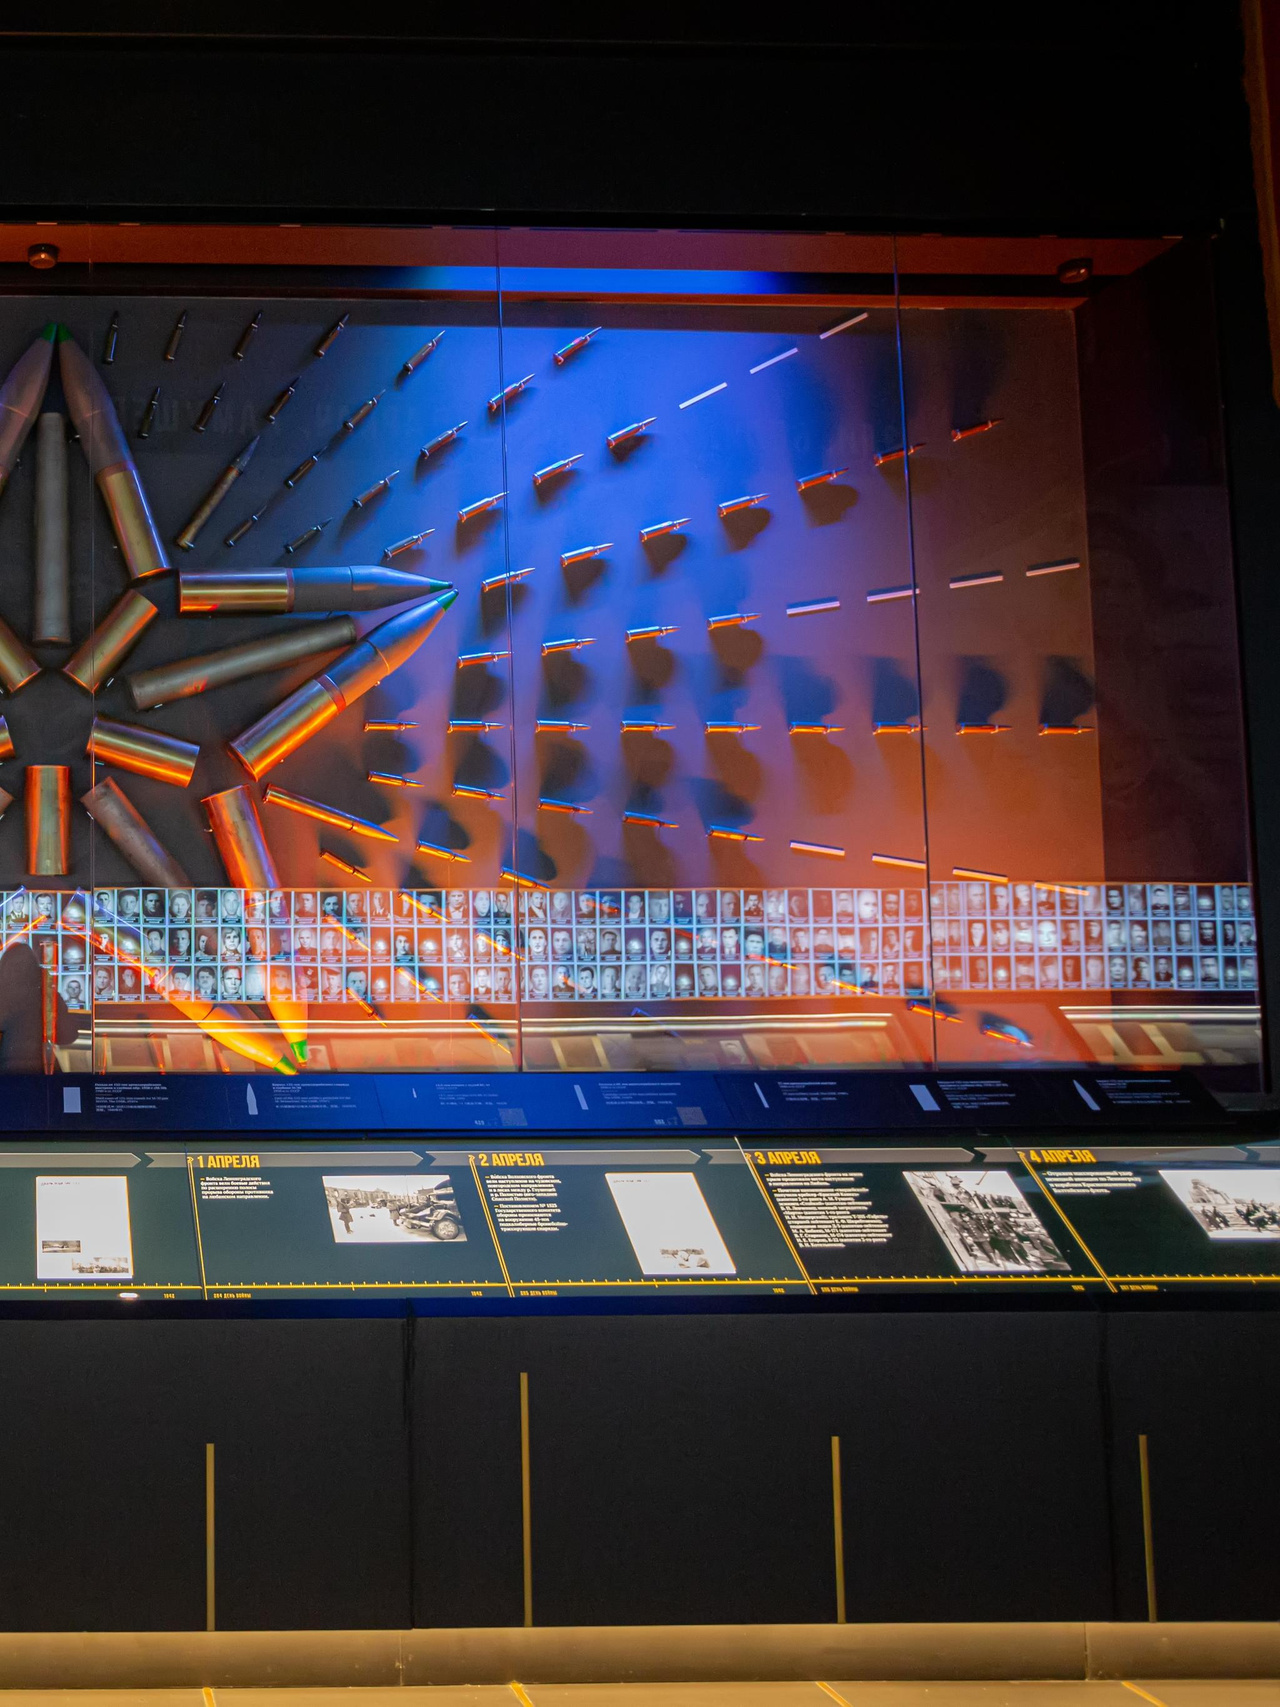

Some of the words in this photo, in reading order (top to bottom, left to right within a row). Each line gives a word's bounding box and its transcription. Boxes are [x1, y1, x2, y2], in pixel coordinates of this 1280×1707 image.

[197, 1155, 204, 1168] 1
[207, 1155, 260, 1168] АПРЕЛЯ
[478, 1153, 490, 1167] 2
[491, 1153, 545, 1167] АПРЕЛЯ
[754, 1151, 766, 1165] 3
[767, 1151, 822, 1165] АПРЕЛЯ
[1029, 1149, 1041, 1163] 4
[1040, 1149, 1097, 1163] АПРЕЛЯ
